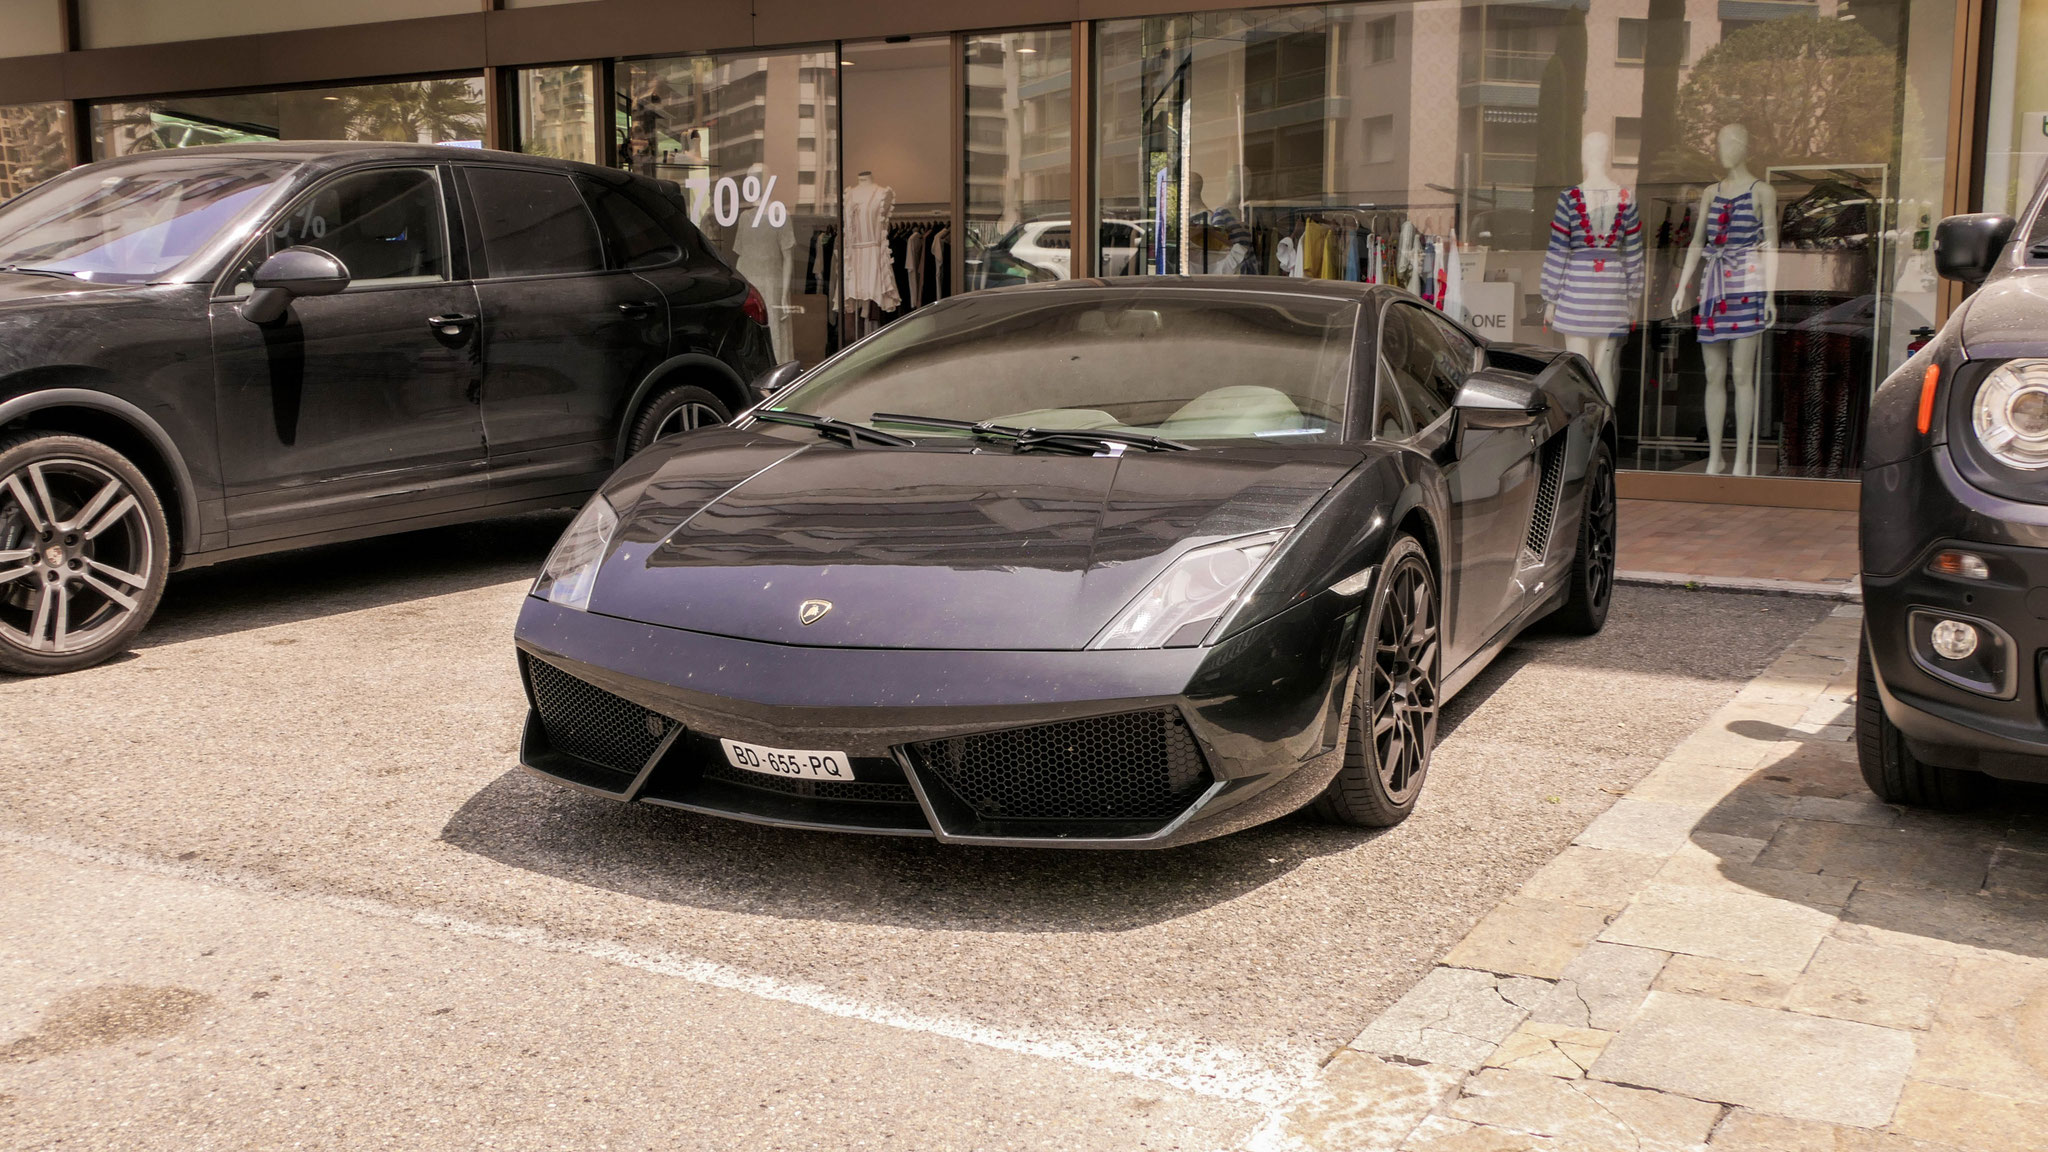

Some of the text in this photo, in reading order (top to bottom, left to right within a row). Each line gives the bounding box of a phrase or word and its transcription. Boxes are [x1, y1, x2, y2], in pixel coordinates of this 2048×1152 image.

[685, 175, 787, 228] 70%
[1471, 314, 1507, 328] ONE
[732, 744, 842, 777] BD-655-PQ
